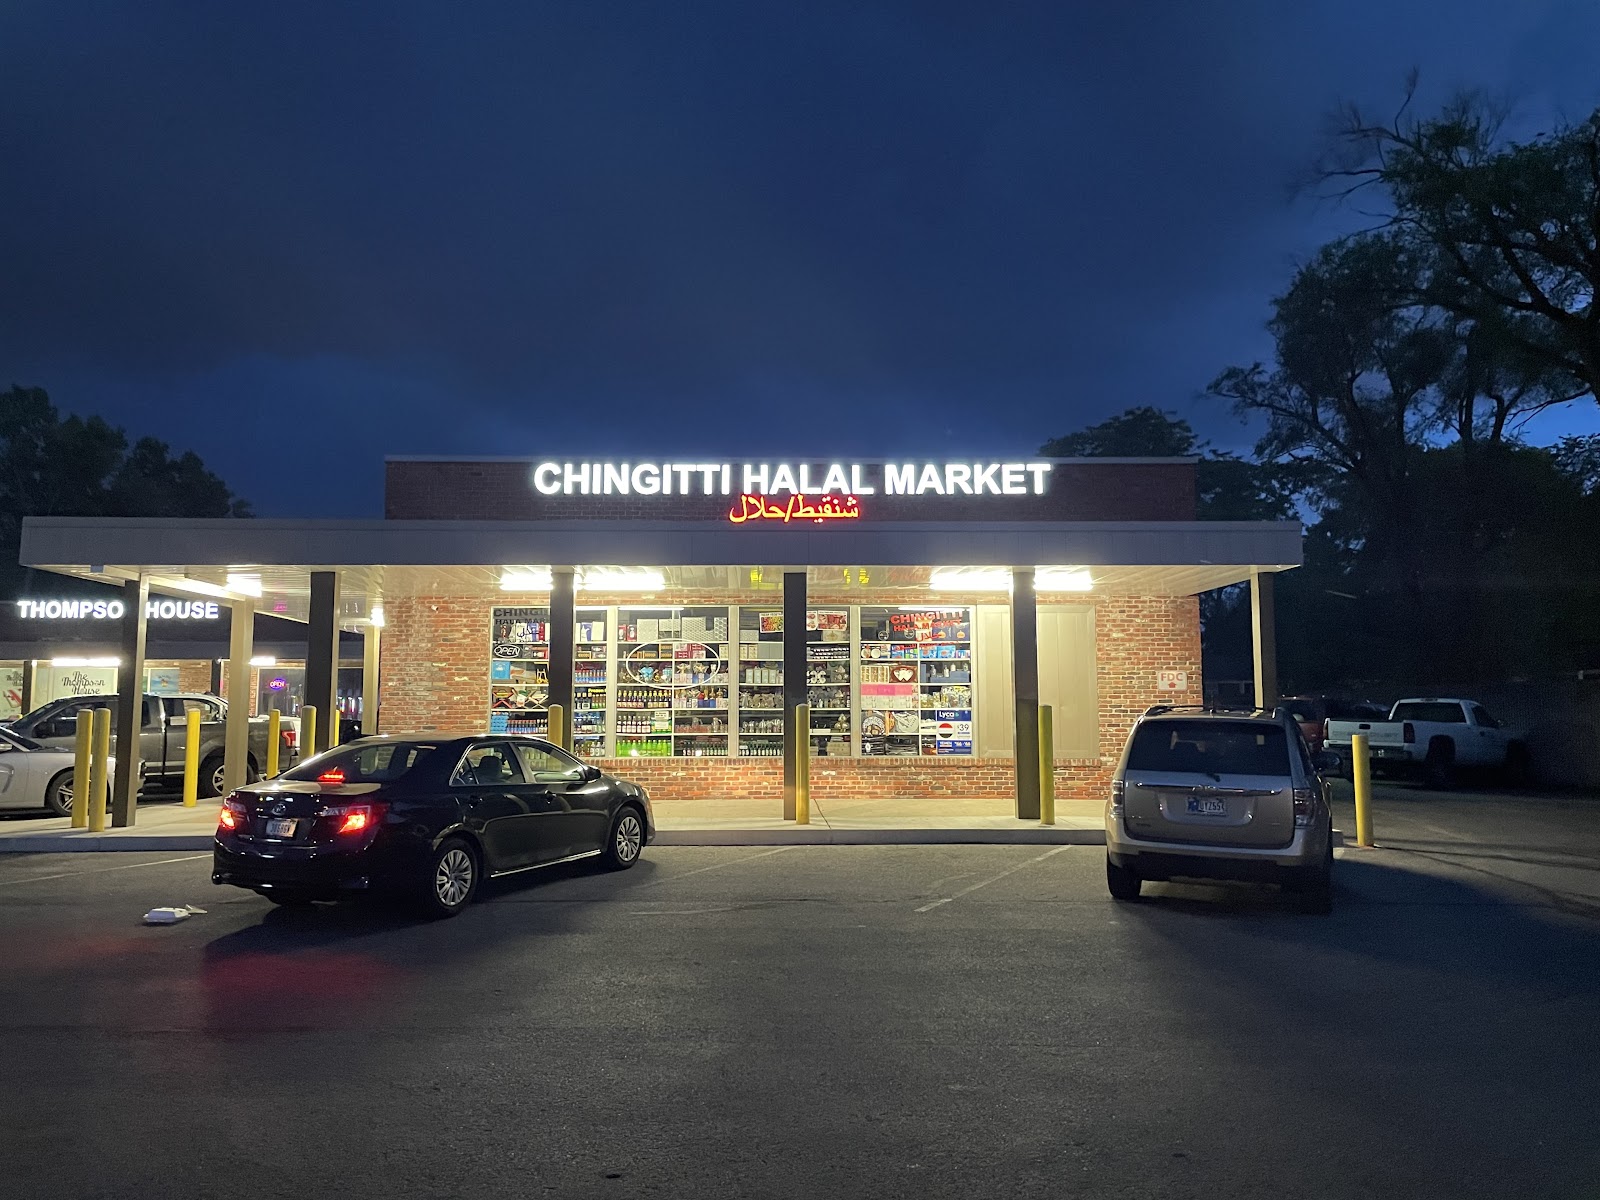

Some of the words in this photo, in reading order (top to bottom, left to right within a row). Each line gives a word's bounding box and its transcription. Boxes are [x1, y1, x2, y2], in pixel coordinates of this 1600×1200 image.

[533, 463, 731, 496] CHINGITTI
[743, 464, 875, 496] HALAL
[884, 463, 1053, 496] MARKET
[18, 600, 125, 618] THOMPSO
[146, 602, 219, 619] HOUSE
[890, 611, 963, 624] CHINGITTI
[495, 646, 518, 656] OPEN
[72, 671, 88, 681] The
[1160, 672, 1183, 682] FDC
[62, 677, 105, 688] Thompson
[939, 710, 955, 719] Lyca
